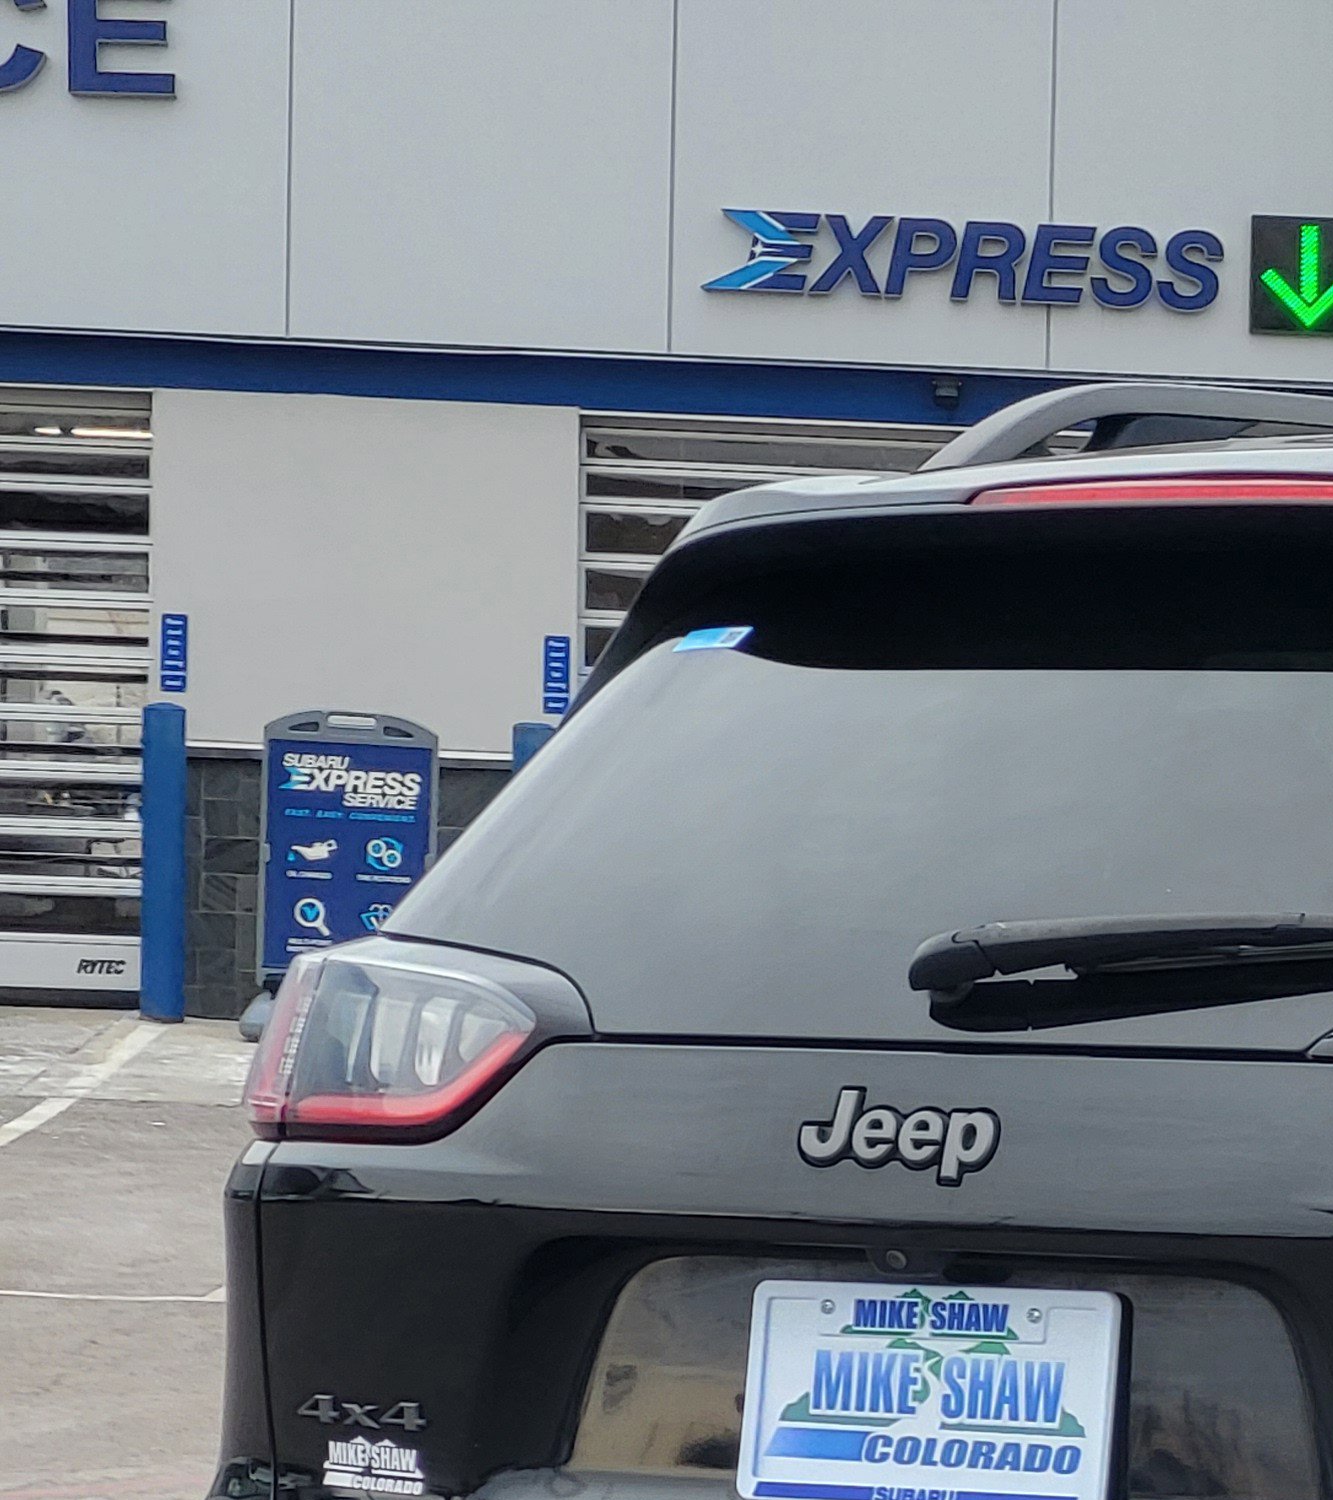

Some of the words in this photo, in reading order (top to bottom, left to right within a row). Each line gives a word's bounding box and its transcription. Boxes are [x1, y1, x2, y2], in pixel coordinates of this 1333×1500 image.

[702, 207, 1224, 312] EXPRESS
[282, 753, 350, 770] SUBARU
[279, 767, 422, 797] EXPRESS
[342, 793, 417, 811] SERVICE
[797, 1085, 1002, 1188] Jeep
[853, 1298, 919, 1330] MIKE
[929, 1302, 1009, 1334] SHAW
[812, 1348, 922, 1416] MIKE
[940, 1355, 1066, 1424] SHAW
[297, 1394, 427, 1432] 4x4
[328, 1440, 366, 1467] MIKE
[370, 1445, 417, 1472] SHAW
[863, 1433, 1082, 1476] COLORADO
[352, 1475, 424, 1496] COLORADO
